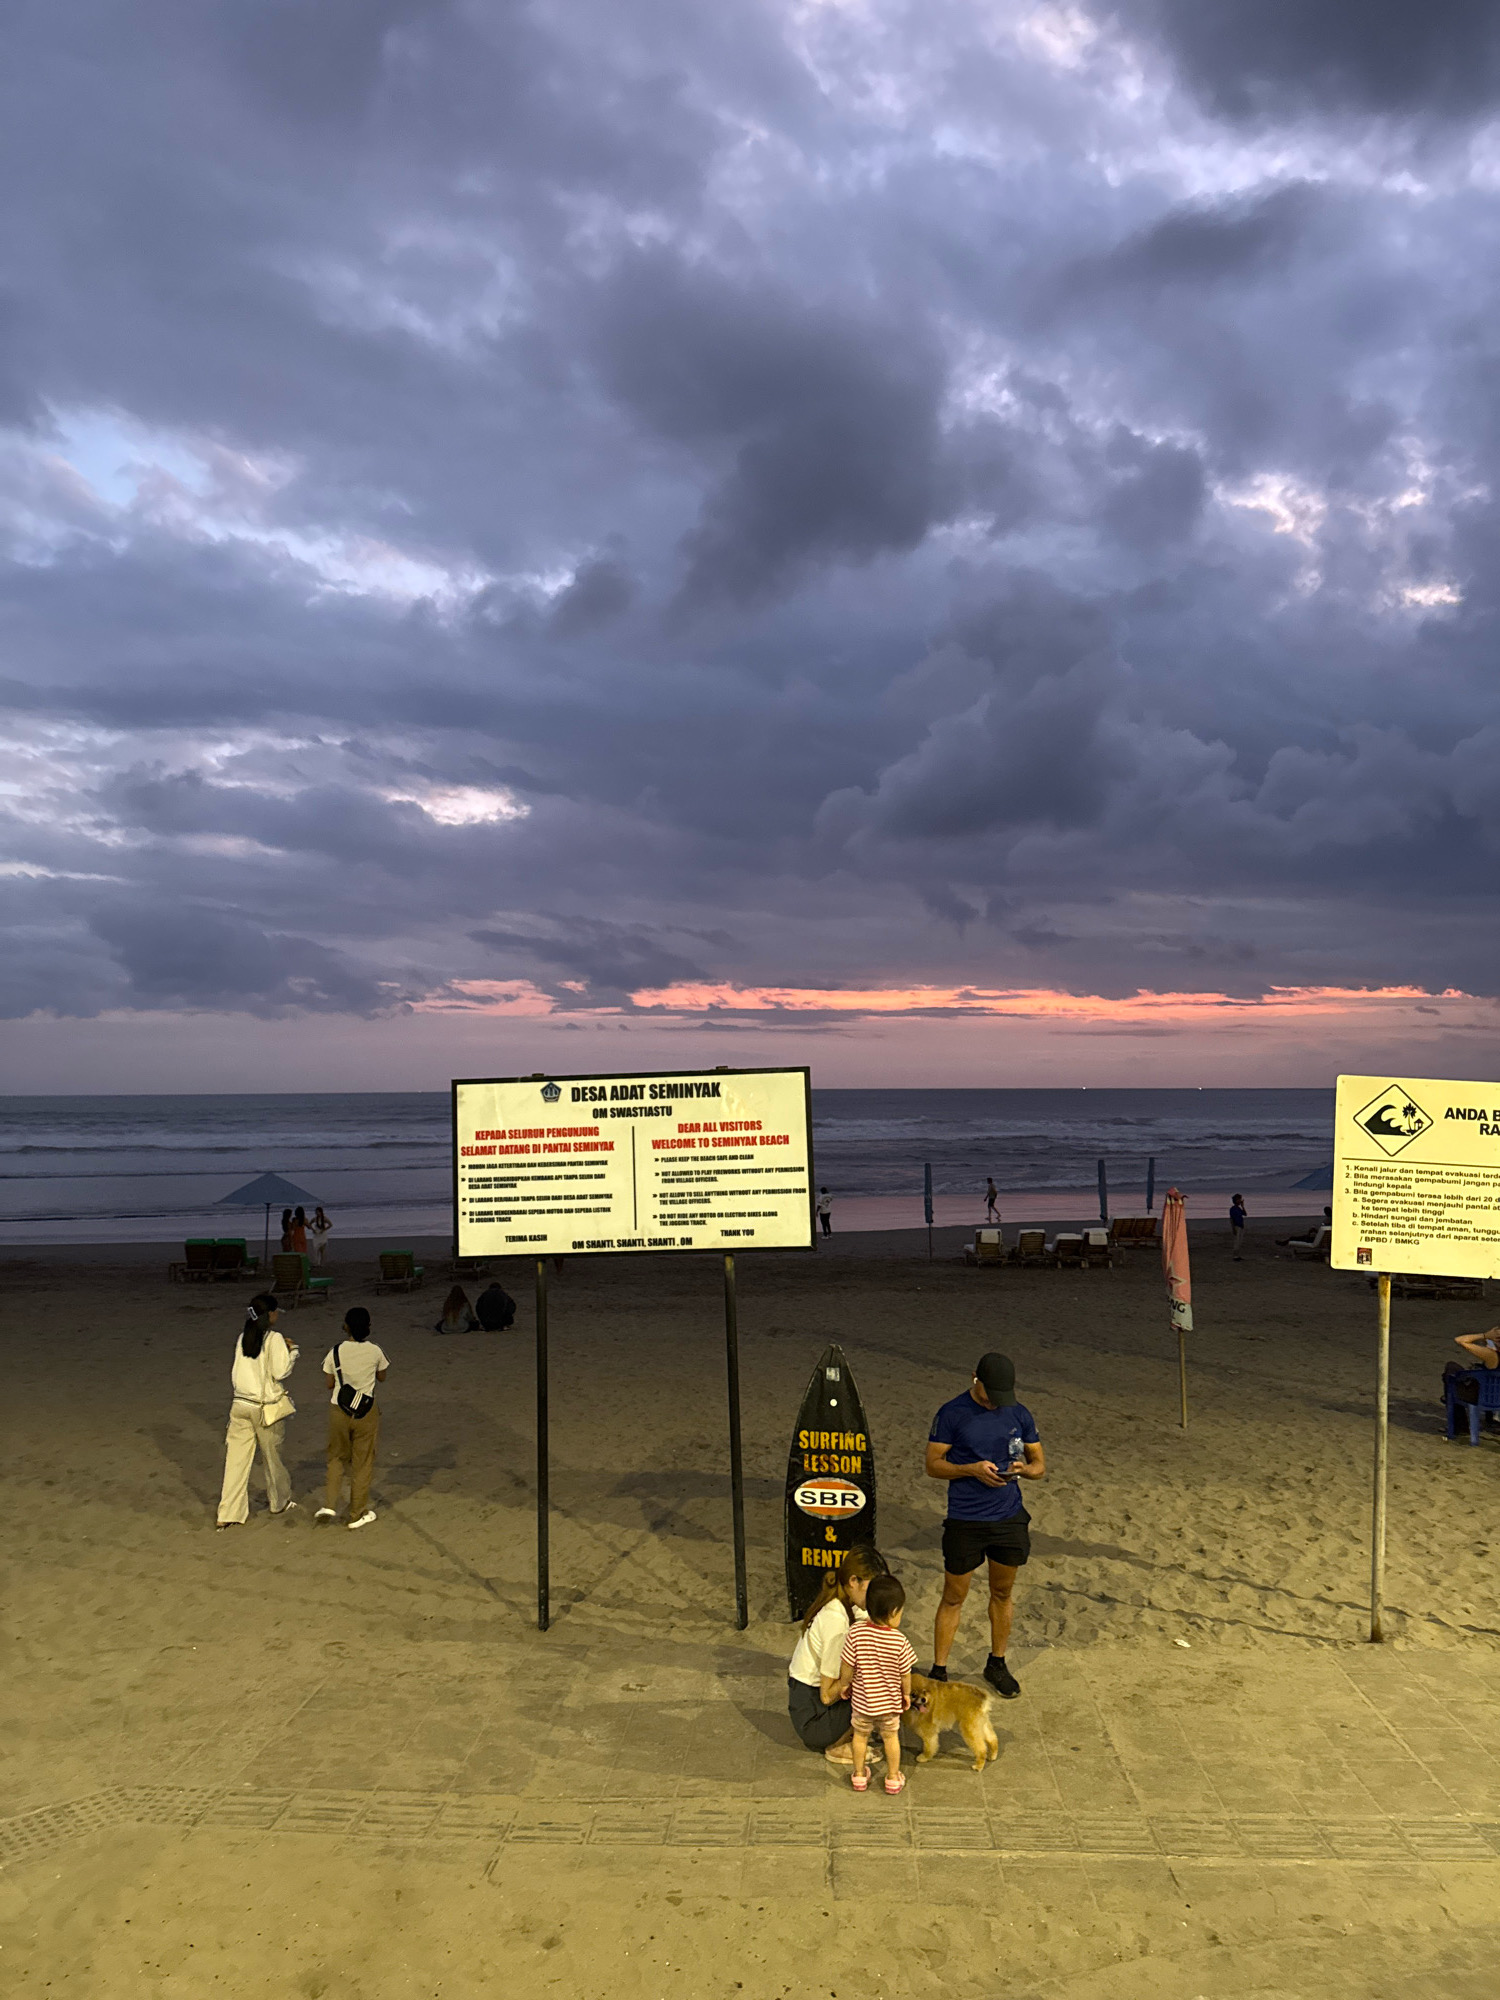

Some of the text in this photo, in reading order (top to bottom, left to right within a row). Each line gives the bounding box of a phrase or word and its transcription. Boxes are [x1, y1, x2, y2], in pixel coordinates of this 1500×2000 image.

[572, 1082, 721, 1102] DESA ADAT SEMINYAK
[593, 1106, 672, 1118] OM SWASTIASTU
[1444, 1108, 1500, 1121] ANDA B
[476, 1126, 599, 1140] KEPADA SELURUH PENGUNJUNG
[678, 1120, 762, 1133] DEAR ALL VISITORS
[1480, 1124, 1500, 1136] RA
[461, 1141, 614, 1156] SELAMAT DATANG DI PANTAI SEMINYAK
[652, 1135, 789, 1149] WELCOME TO SEMINYAK BEACH
[572, 1240, 584, 1249] OM
[682, 1237, 692, 1246] OM
[798, 1430, 866, 1452] SURFING
[804, 1454, 862, 1474] LESSON
[800, 1491, 860, 1507] SBR
[825, 1526, 837, 1542] &
